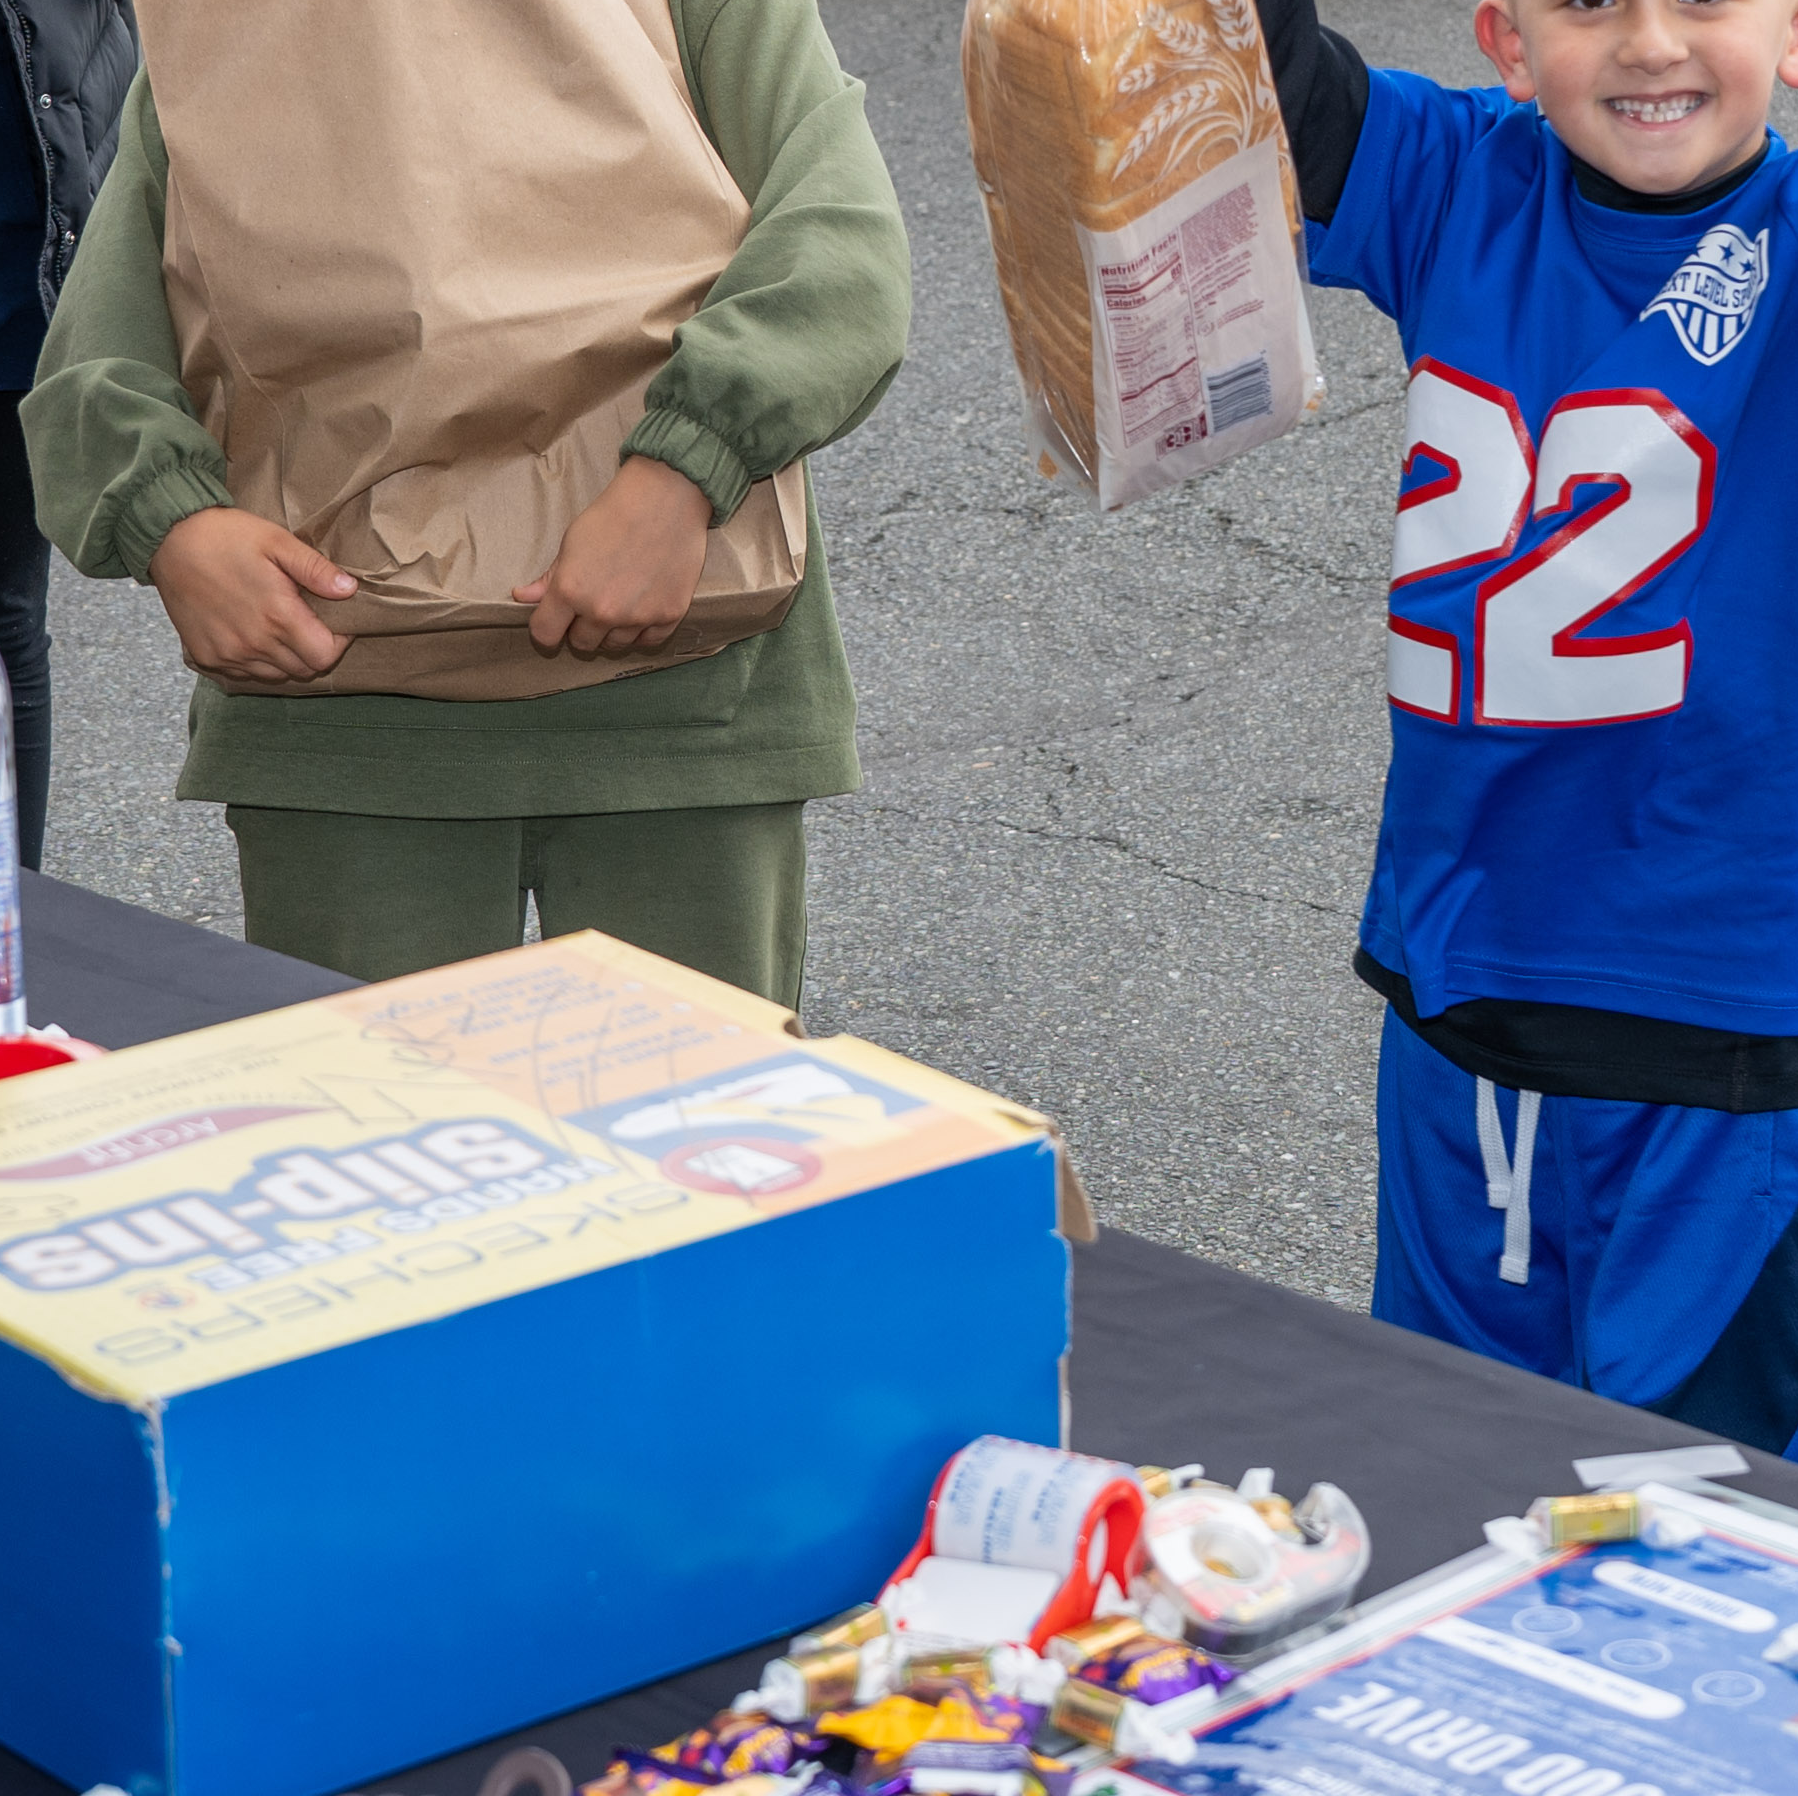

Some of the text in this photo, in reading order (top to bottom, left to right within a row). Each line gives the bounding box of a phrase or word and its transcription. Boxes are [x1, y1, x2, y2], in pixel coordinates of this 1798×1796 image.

[1100, 231, 1178, 277] Nutrition Facts
[1106, 295, 1147, 308] Calories
[1387, 354, 1718, 729] 22
[2, 1121, 547, 1287] Slip-ins
[96, 1181, 690, 1365] SKECHERS
[187, 1154, 620, 1292] HANDS FREE
[1313, 1680, 1532, 1775] DRIVE
